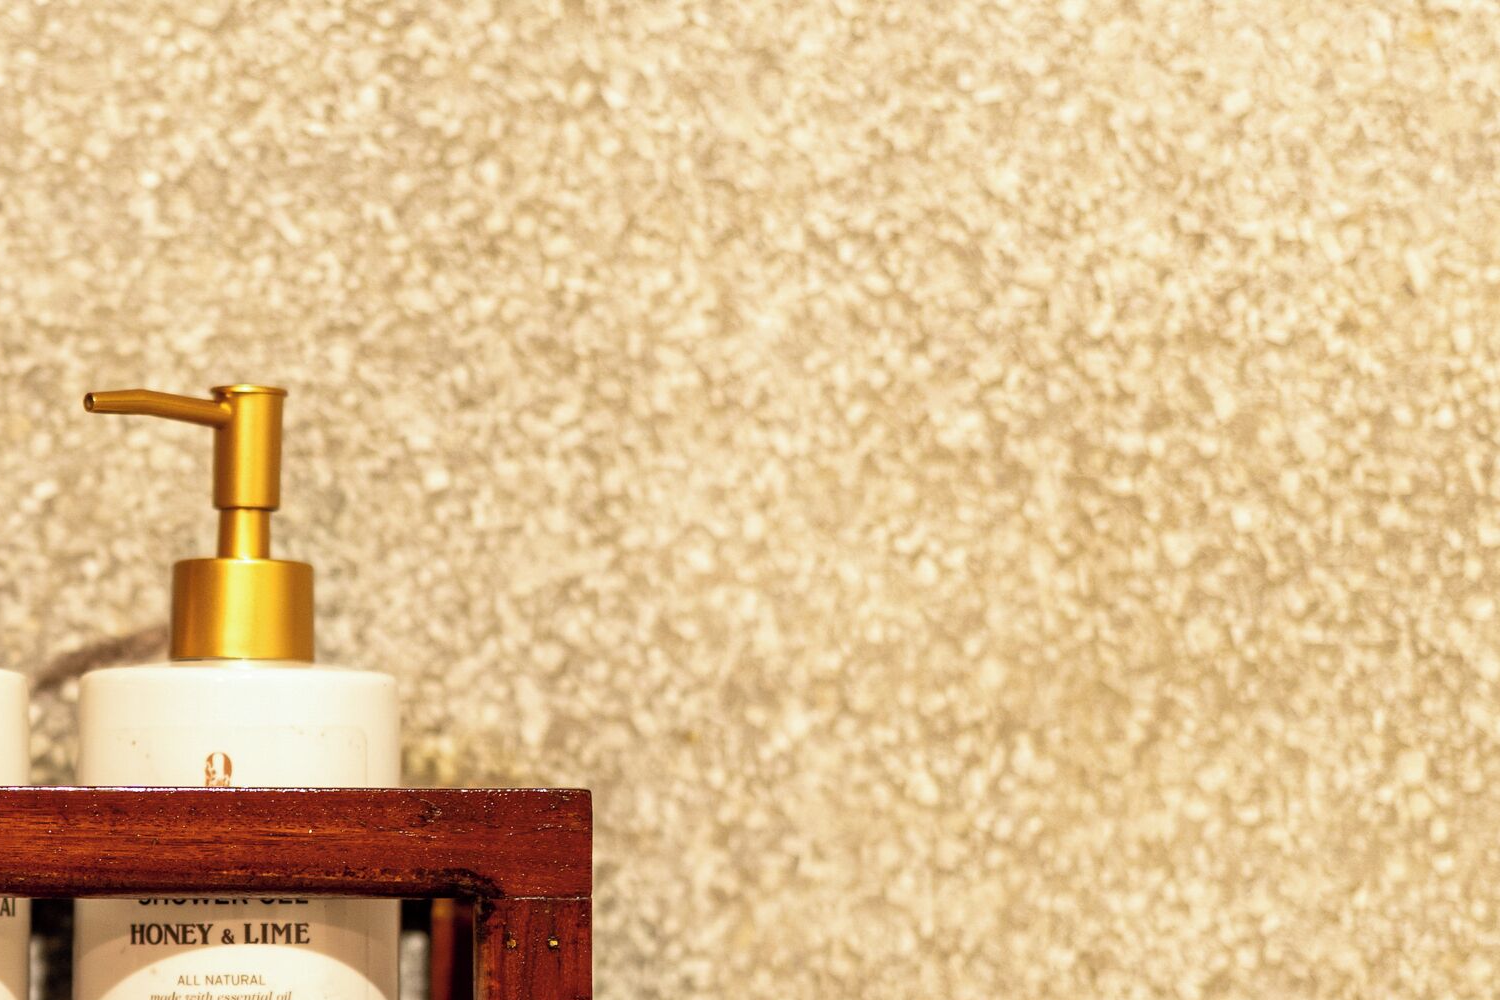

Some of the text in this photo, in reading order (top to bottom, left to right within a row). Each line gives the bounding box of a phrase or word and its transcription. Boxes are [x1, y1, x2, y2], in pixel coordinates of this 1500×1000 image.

[130, 922, 310, 945] HONEY & LIME
[177, 974, 266, 986] ALL NATURAL
